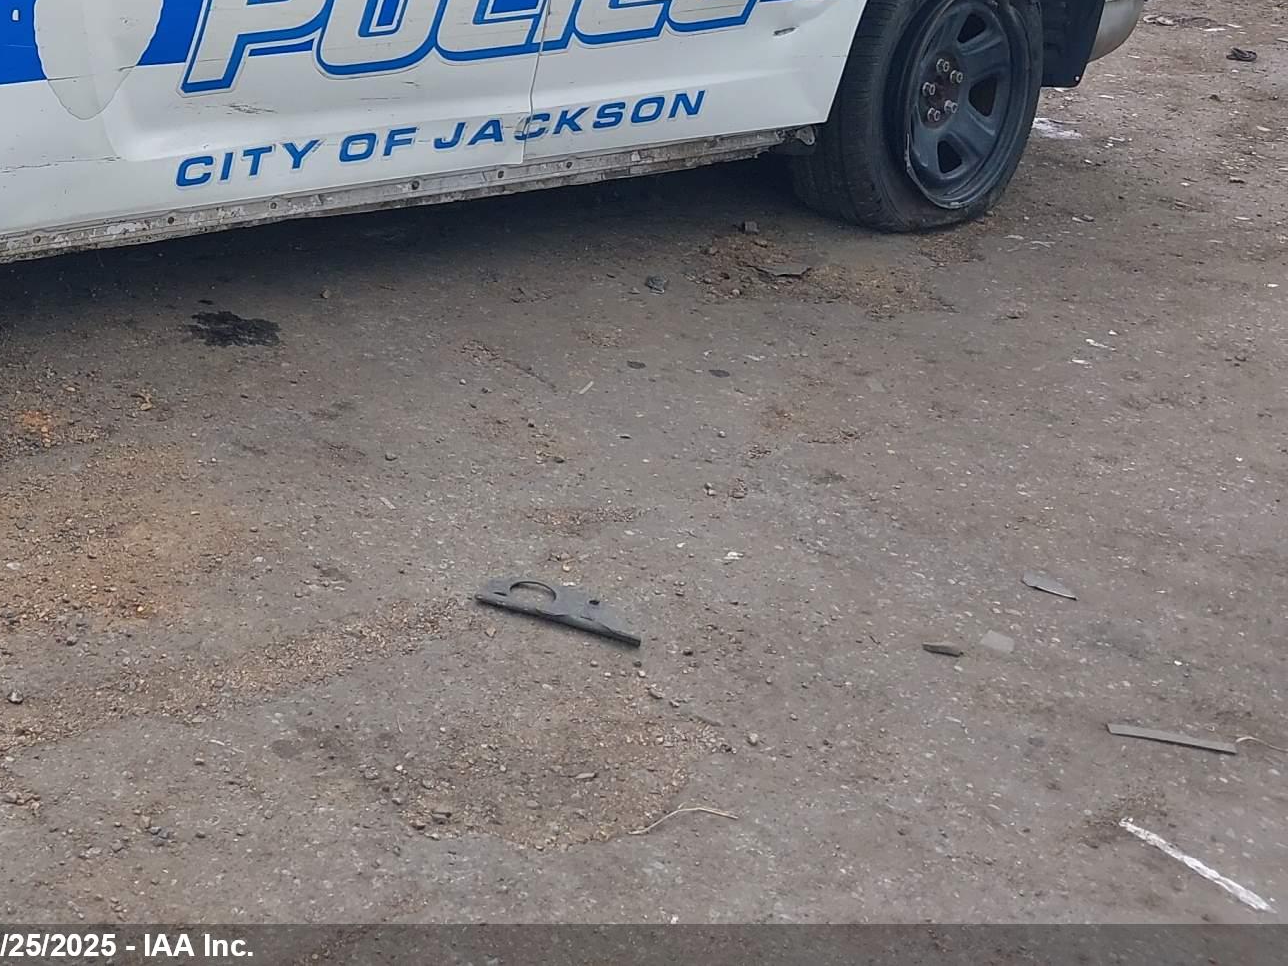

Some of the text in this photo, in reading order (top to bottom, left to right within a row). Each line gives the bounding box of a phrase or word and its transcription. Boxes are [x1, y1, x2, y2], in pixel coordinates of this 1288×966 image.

[176, 89, 706, 188] CITY OF JACKSON
